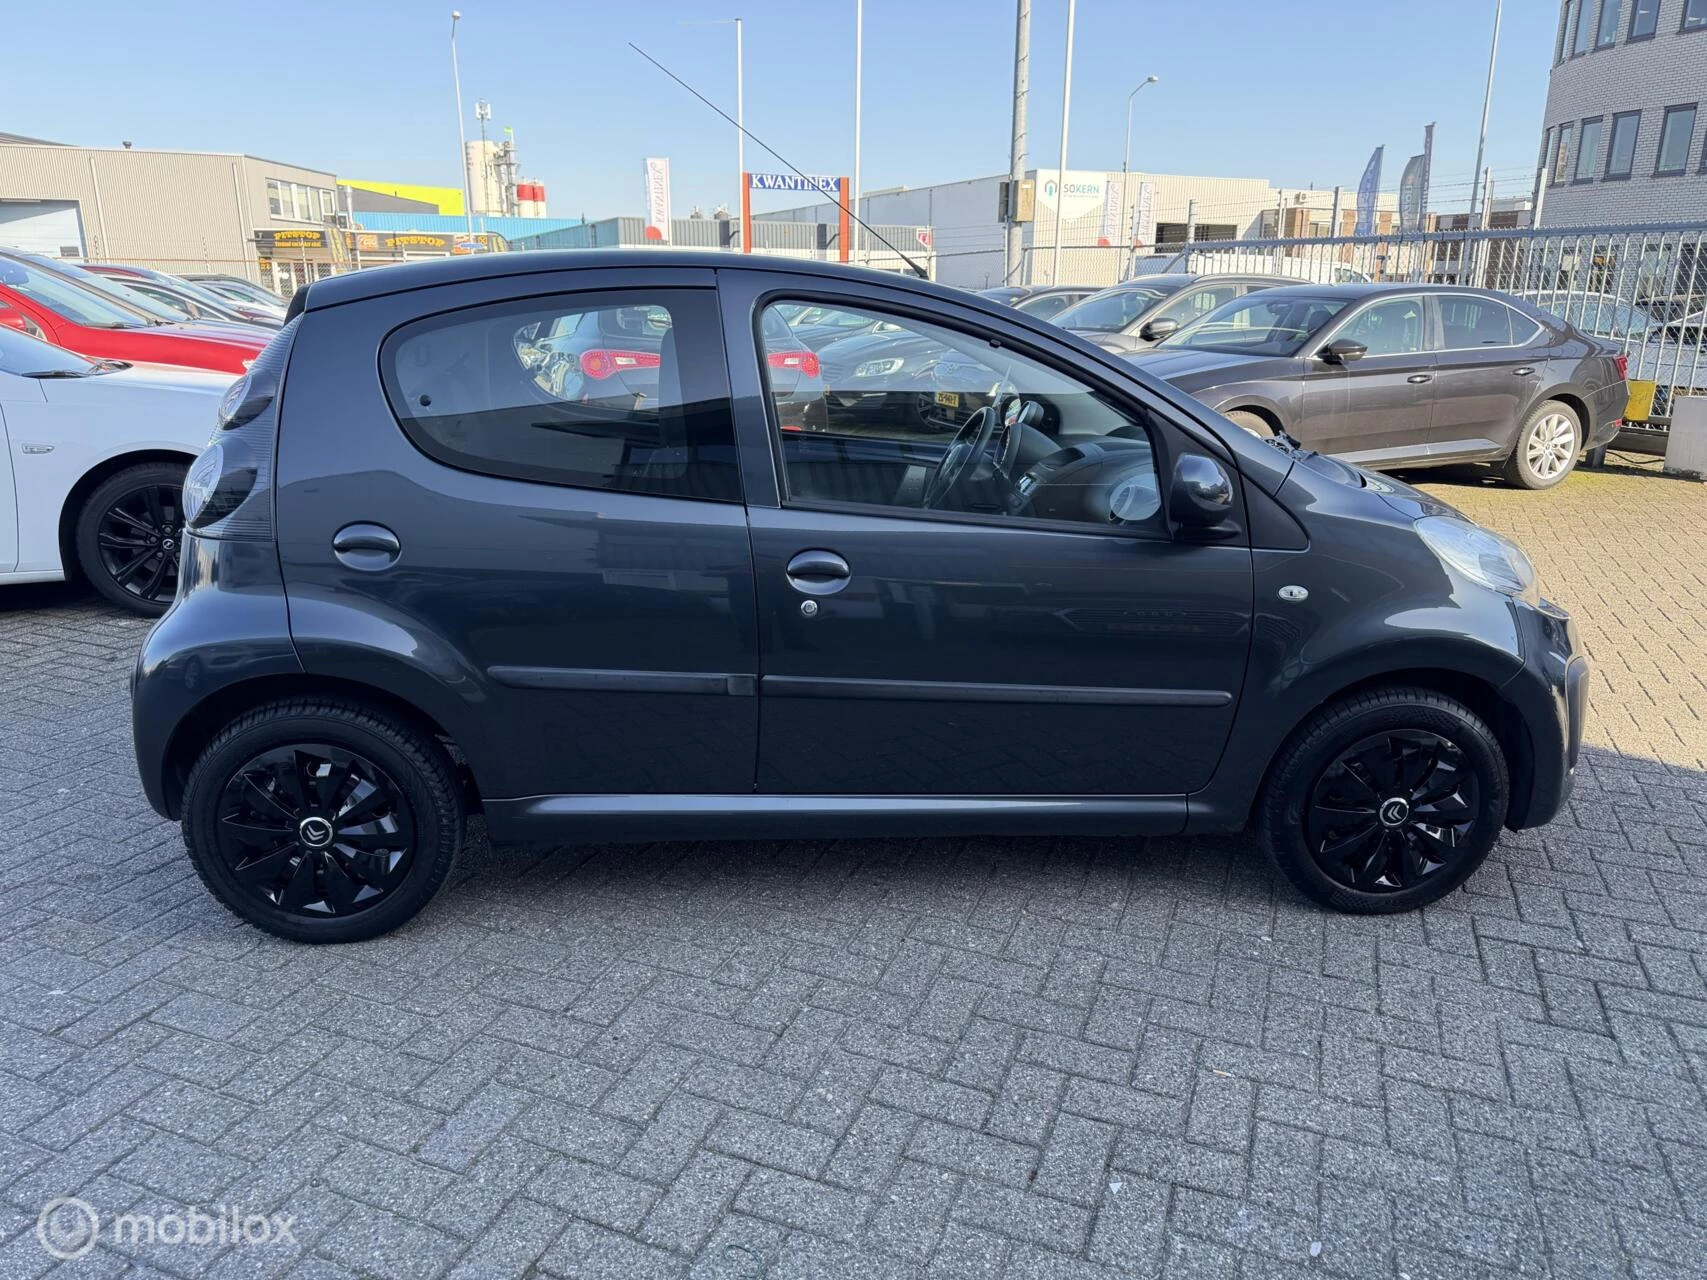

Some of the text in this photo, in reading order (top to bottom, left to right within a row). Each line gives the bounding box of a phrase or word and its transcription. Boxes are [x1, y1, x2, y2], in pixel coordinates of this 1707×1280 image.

[751, 174, 837, 191] KWANTINEX
[1063, 183, 1099, 193] SOKERN
[273, 231, 321, 240] PITSTOP
[386, 236, 446, 247] PITSTOP
